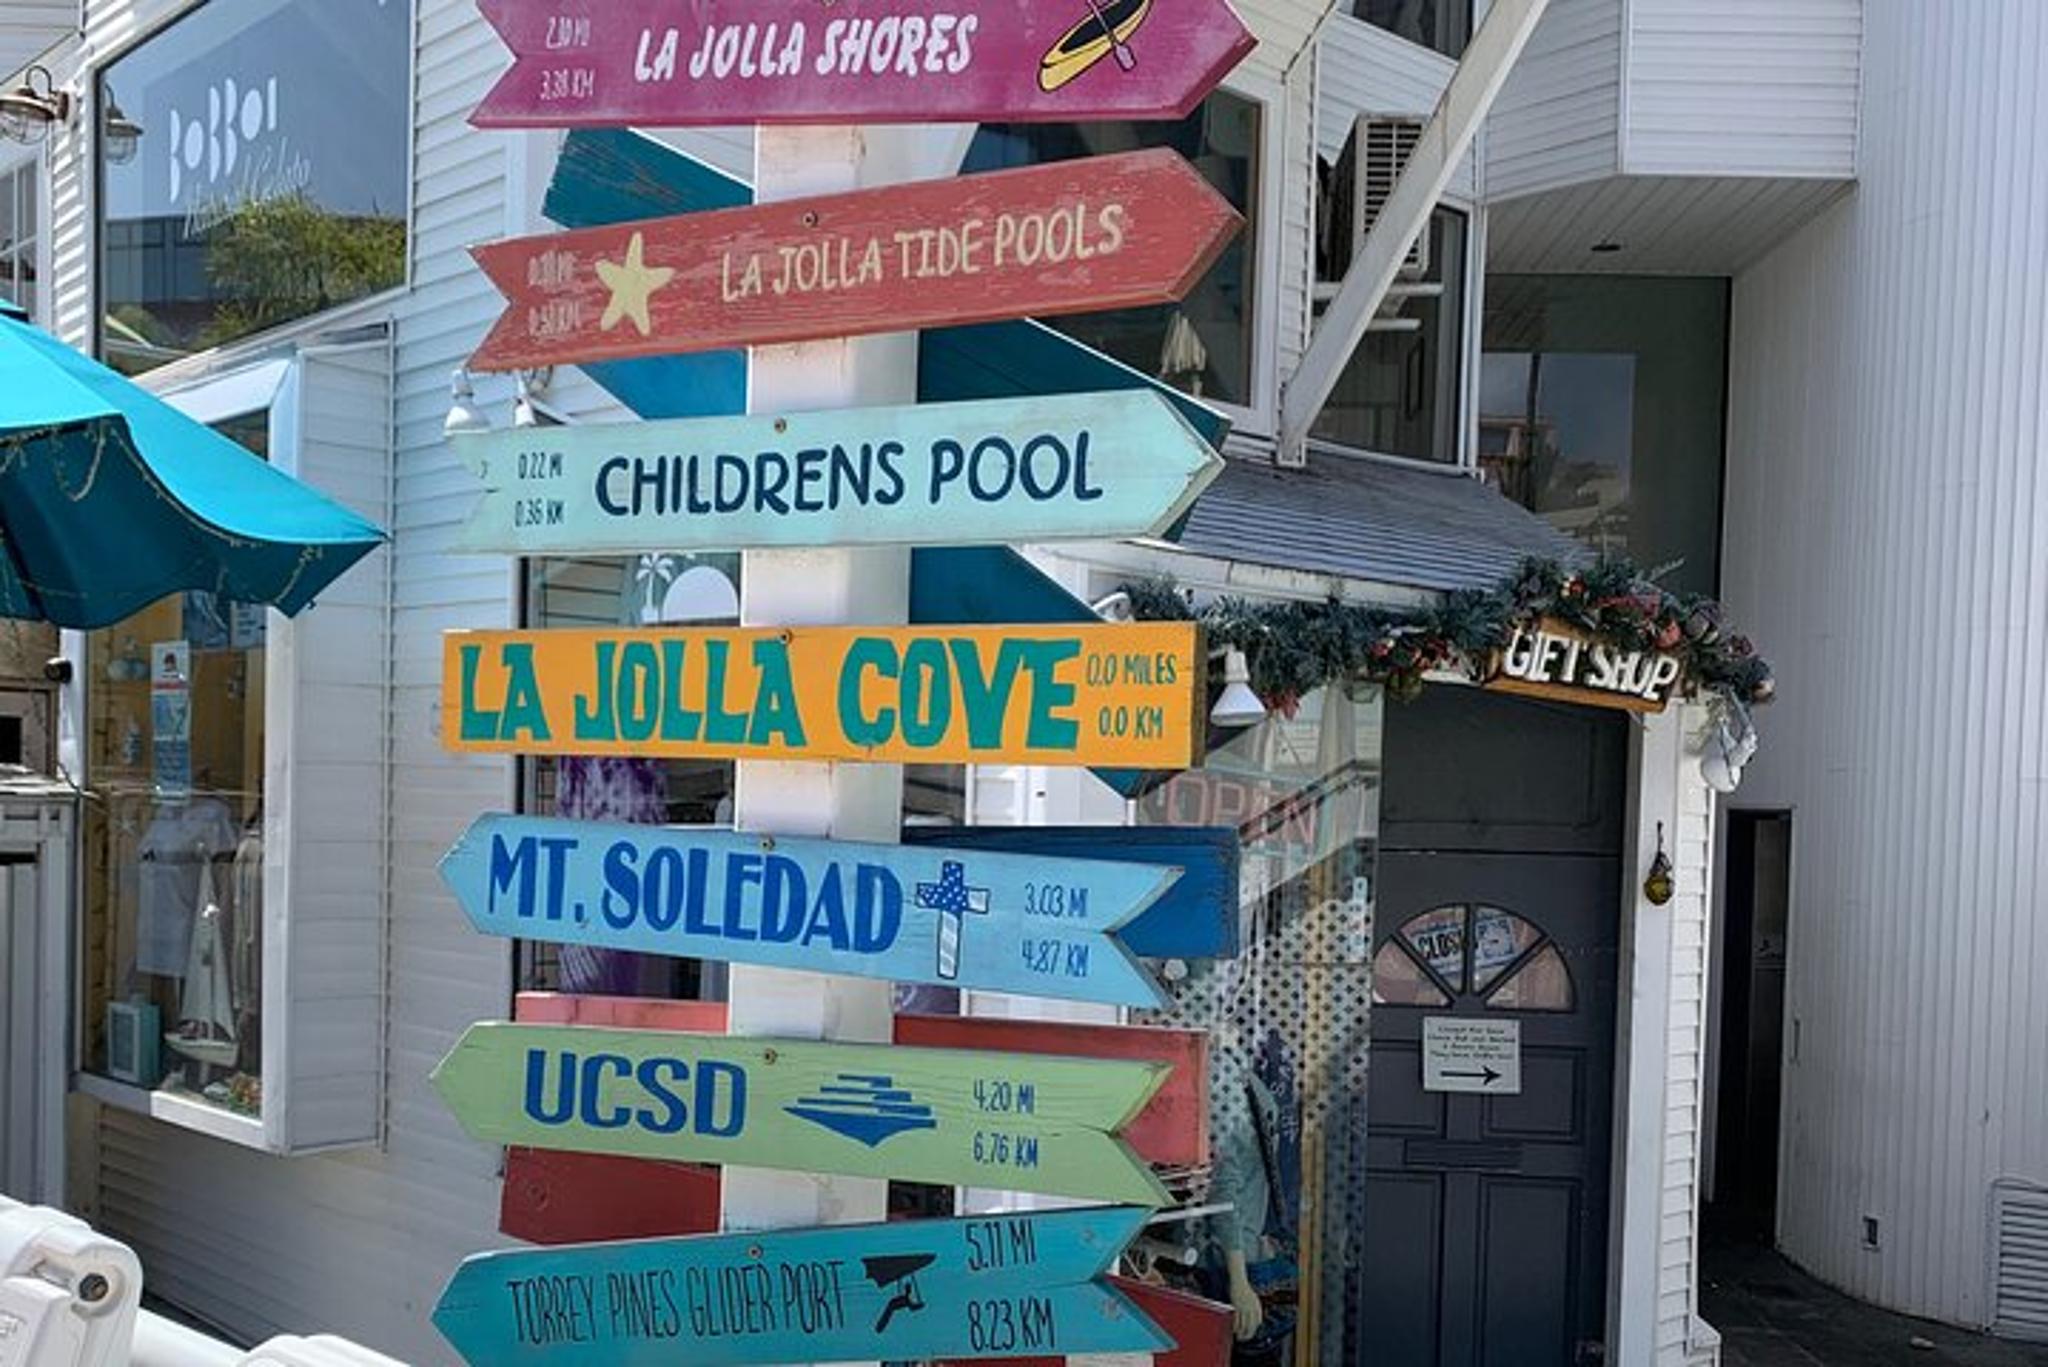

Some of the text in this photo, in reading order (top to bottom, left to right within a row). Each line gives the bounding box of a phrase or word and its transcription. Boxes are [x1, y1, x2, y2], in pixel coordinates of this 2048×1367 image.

[634, 14, 978, 82] LA JOLLA SHORES
[572, 68, 595, 98] KM
[721, 203, 1124, 302] LA JOLLA TIDE POOLS
[518, 452, 563, 479] 0.22 MI
[595, 430, 1103, 516] CHILDRENS POOL
[515, 500, 564, 527] 0.36 KM
[1086, 652, 1177, 684] 0.0 MILES
[1504, 625, 1588, 683] GIFT
[460, 637, 1082, 750] LA JOLLA COVE
[1099, 706, 1163, 738] 0.0 KM
[601, 840, 903, 955] SOLEDAD
[1024, 882, 1088, 918] 3.03 MI
[1022, 939, 1090, 978] 4.87 KM
[525, 1049, 748, 1137] UCSD
[973, 1080, 1036, 1115] 4.20 MI
[973, 1131, 1038, 1168] 6.76 KM
[965, 1219, 1037, 1271] 5.11 MI
[507, 1260, 846, 1345] TORREY PINES GLIDER PORT
[968, 1297, 1056, 1350] 8.23 KM
